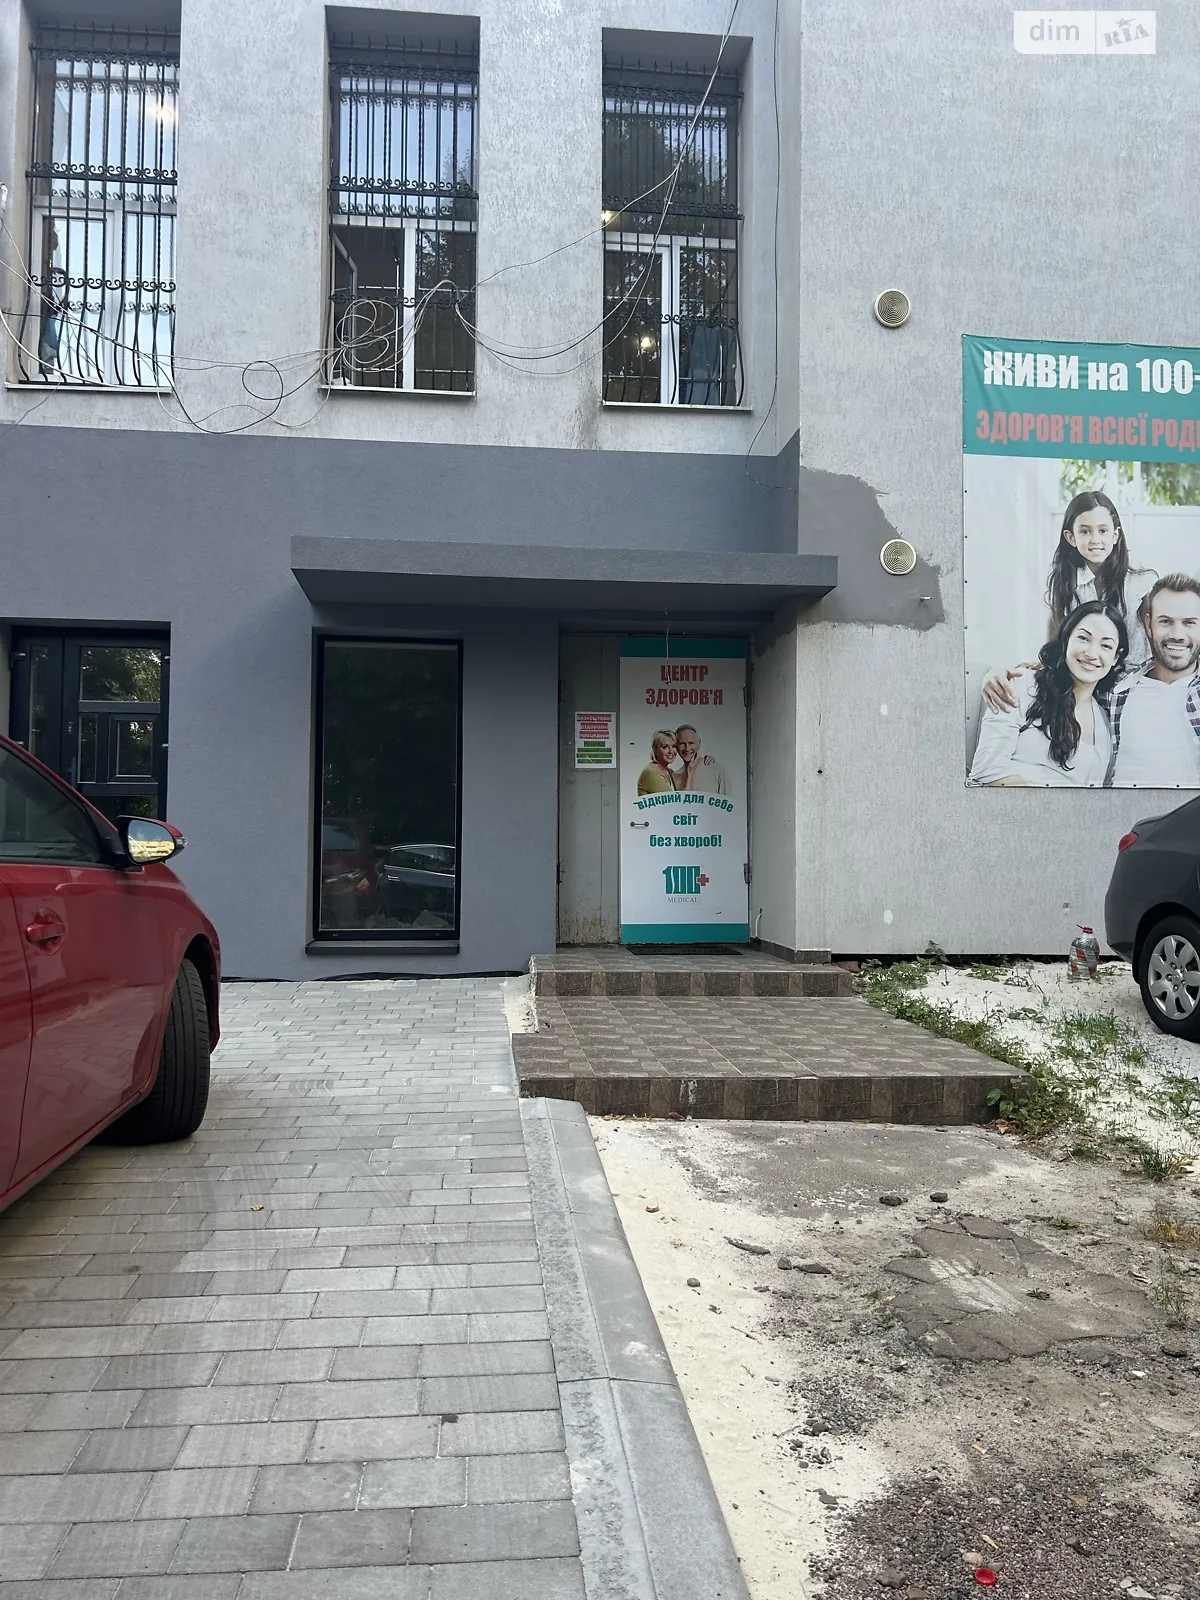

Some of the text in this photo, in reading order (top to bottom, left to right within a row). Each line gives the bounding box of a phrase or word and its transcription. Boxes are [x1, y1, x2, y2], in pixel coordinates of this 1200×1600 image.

[983, 350, 1200, 395] ЖИВИ на 100
[976, 409, 1083, 445] ЗДОРОВ'Я
[1088, 412, 1147, 446] ВСІЄЇ
[660, 664, 709, 684] ЦЕНТР
[645, 688, 723, 707] ЗДОРОВ'Я
[637, 791, 734, 813] відкрий для себе
[672, 813, 698, 826] світ
[649, 834, 722, 848] без хвороб!
